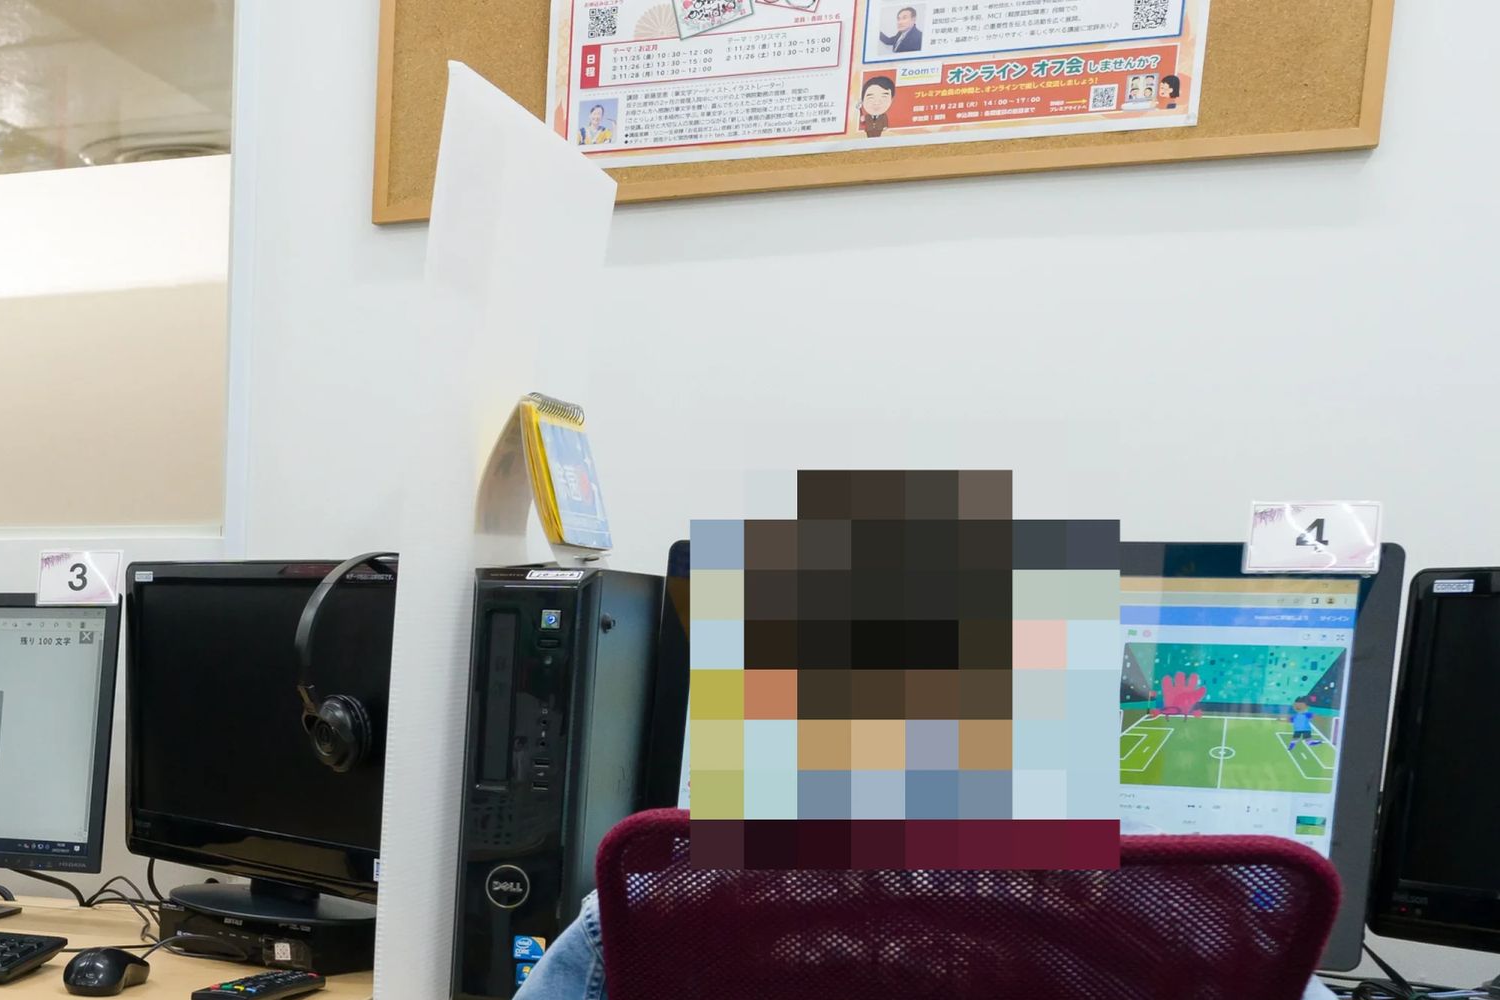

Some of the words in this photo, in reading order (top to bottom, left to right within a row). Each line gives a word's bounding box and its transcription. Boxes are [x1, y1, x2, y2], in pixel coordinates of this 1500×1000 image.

[948, 61, 1027, 84] オンライン
[1032, 57, 1084, 77] オフ会
[68, 563, 88, 591] 3
[38, 637, 53, 646] 100
[55, 637, 71, 646] 文字
[492, 880, 523, 892] DELL
